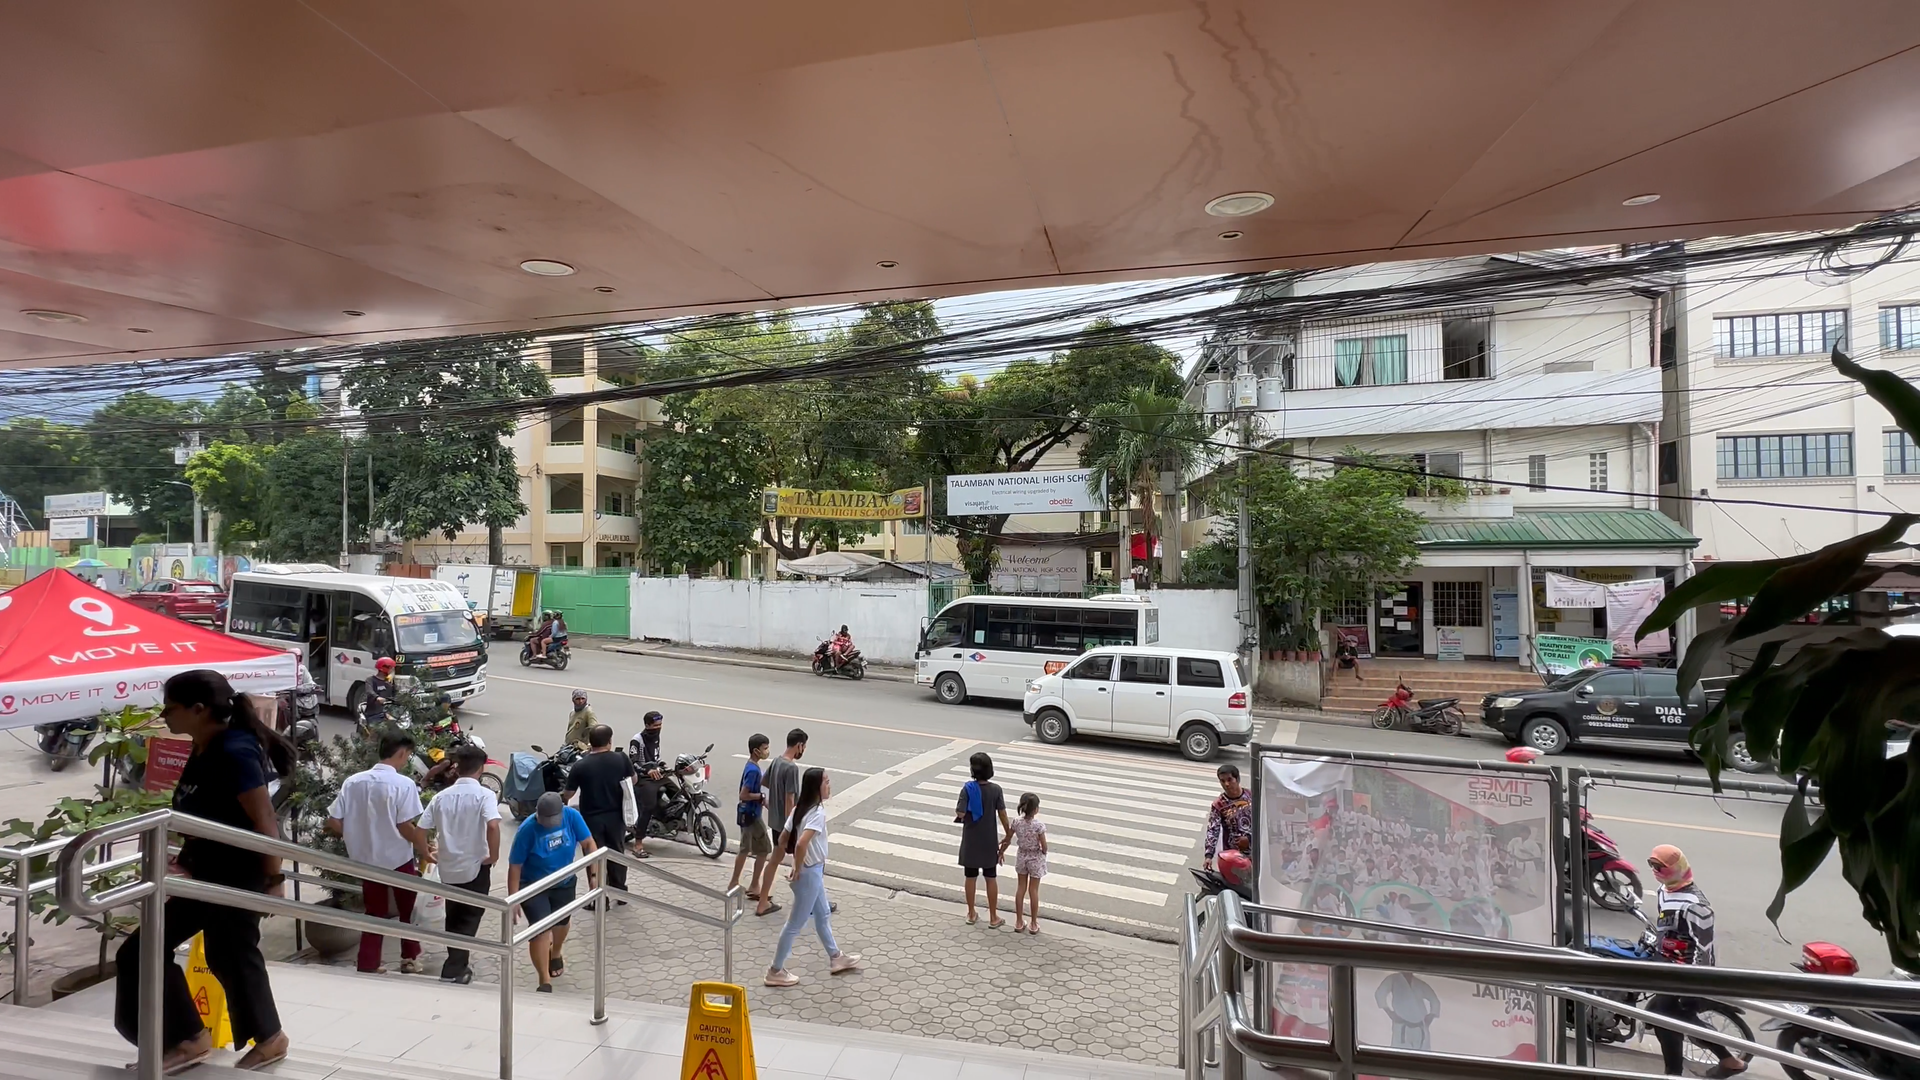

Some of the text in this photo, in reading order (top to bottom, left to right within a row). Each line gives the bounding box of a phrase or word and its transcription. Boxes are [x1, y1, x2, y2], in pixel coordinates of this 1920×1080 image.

[950, 474, 1090, 488] TALAMBAN NATIONAL HIGH SCHO
[794, 490, 892, 508] TALAMBAN
[781, 506, 900, 517] NATIONAL HIGH SCHOOL
[1004, 554, 1050, 564] Welcome
[48, 641, 198, 666] MOVE IT
[132, 680, 164, 692] MOV
[22, 688, 104, 706] MOVE IT
[1655, 706, 1686, 716] DIAL
[1660, 715, 1682, 724] 166
[700, 1024, 731, 1034] CAUTION
[693, 1034, 709, 1042] WET
